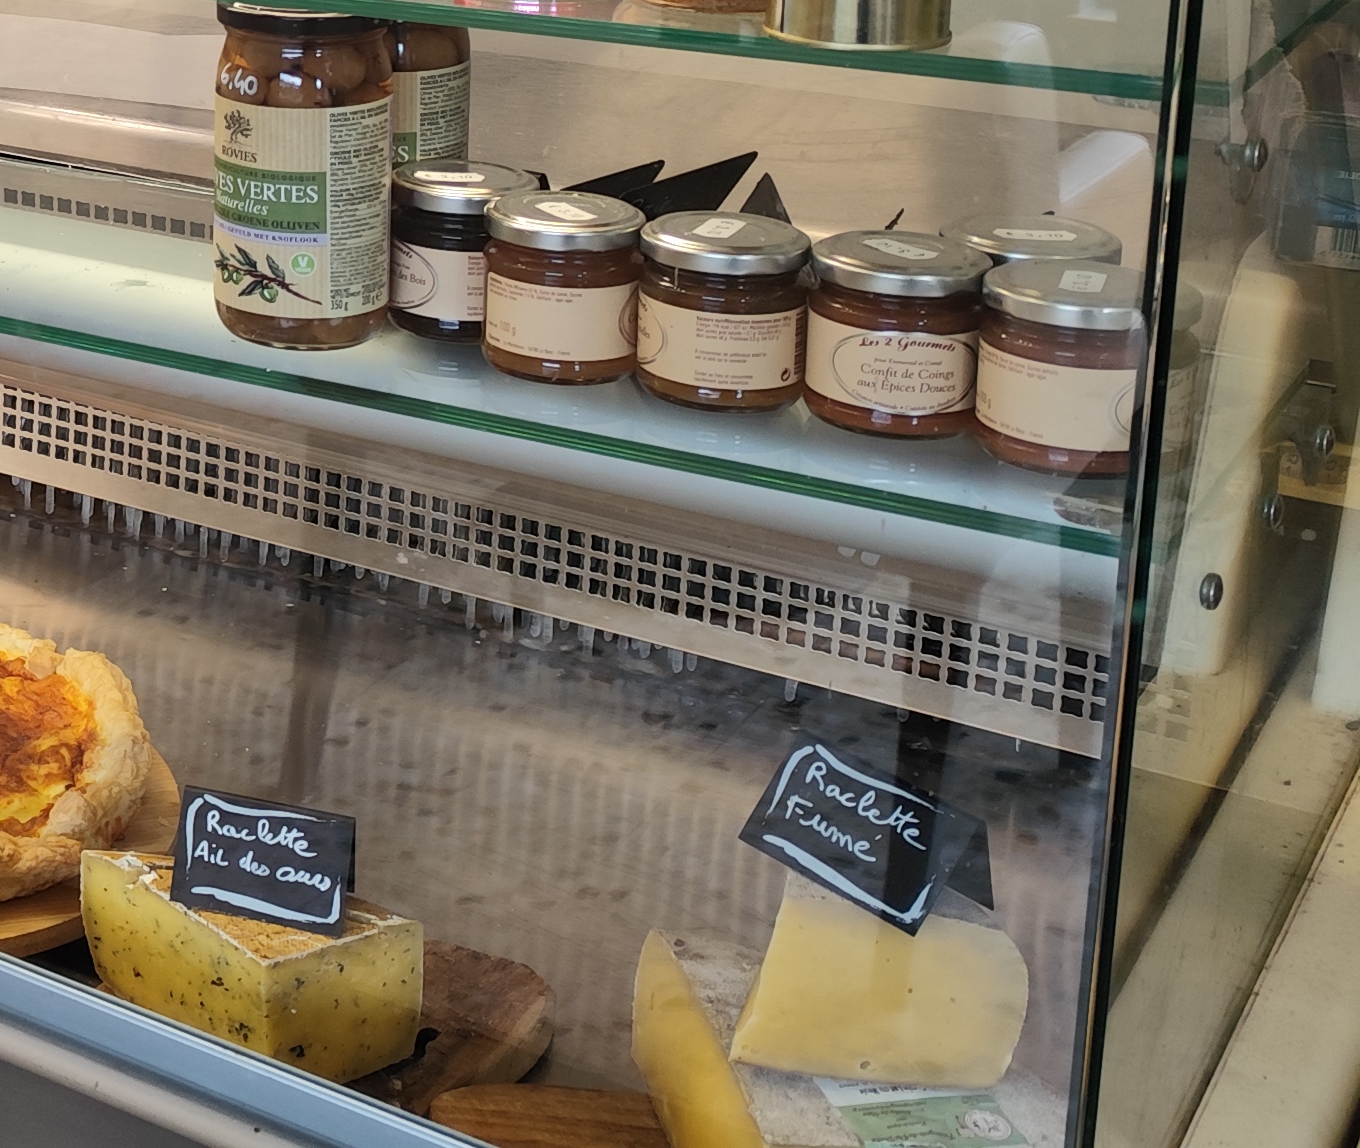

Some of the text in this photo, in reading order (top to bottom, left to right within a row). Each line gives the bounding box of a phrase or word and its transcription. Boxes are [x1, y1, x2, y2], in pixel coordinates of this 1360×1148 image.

[220, 61, 258, 96] 6,40
[221, 145, 258, 163] ROVIES
[261, 172, 317, 183] BIOLOGIQUE
[237, 178, 319, 204] VERTES
[253, 232, 270, 241] MET
[271, 235, 319, 244] KNOFLOOK
[409, 272, 427, 286] Bois
[858, 335, 957, 352] Les 2 Gourmets
[860, 363, 955, 382] Confit de Coings
[856, 379, 877, 389] aux
[919, 382, 956, 394] Douces
[804, 761, 927, 851] Raclette
[206, 809, 318, 858] Raclette
[784, 794, 883, 862] Fumé
